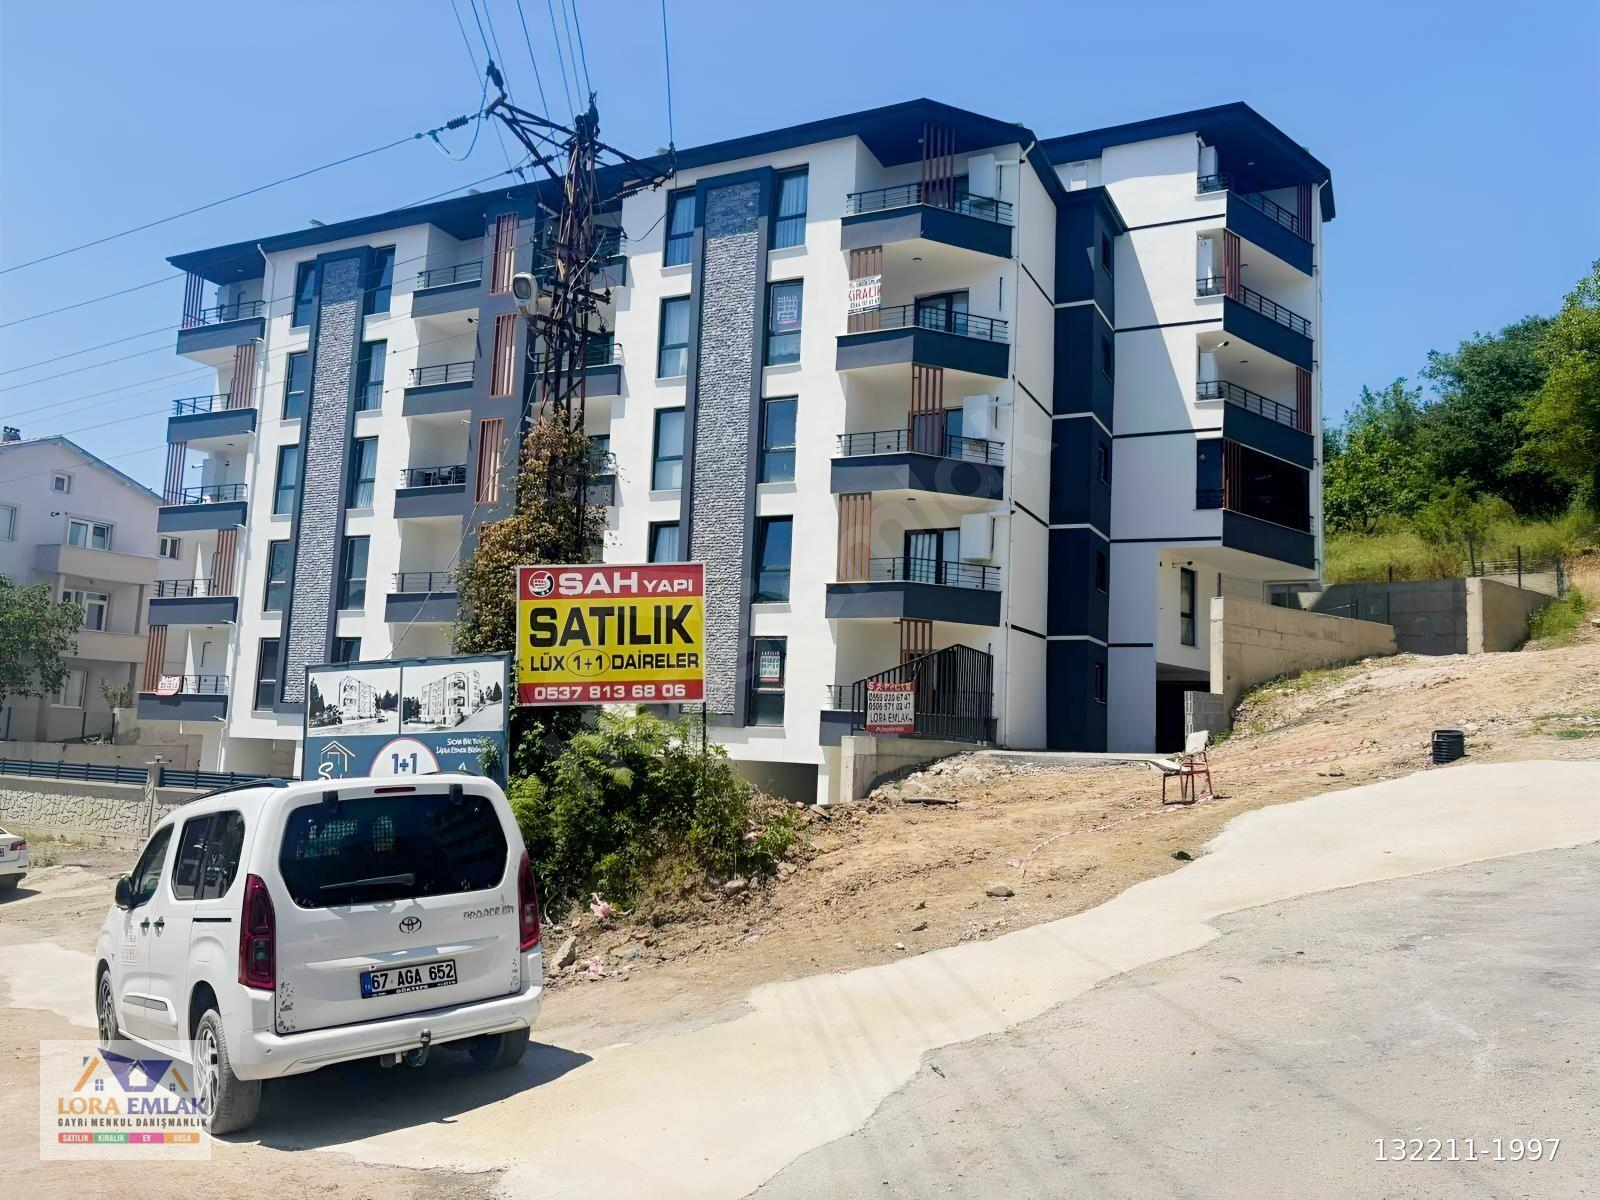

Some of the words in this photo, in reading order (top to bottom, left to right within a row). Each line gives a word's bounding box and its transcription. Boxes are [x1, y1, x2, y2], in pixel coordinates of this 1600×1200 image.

[558, 572, 638, 595] SAH
[643, 579, 693, 593] YAPI
[529, 605, 695, 648] SATILIK
[531, 652, 565, 672] LÜX
[573, 655, 603, 670] 1+1
[611, 650, 699, 670] DAİRELER
[534, 687, 582, 700] 0537
[589, 686, 625, 698] 813
[632, 685, 655, 697] 68
[662, 684, 686, 697] 06
[392, 753, 417, 774] 1+1
[371, 973, 389, 989] 67
[397, 968, 422, 986] AGA
[428, 963, 454, 980] 652
